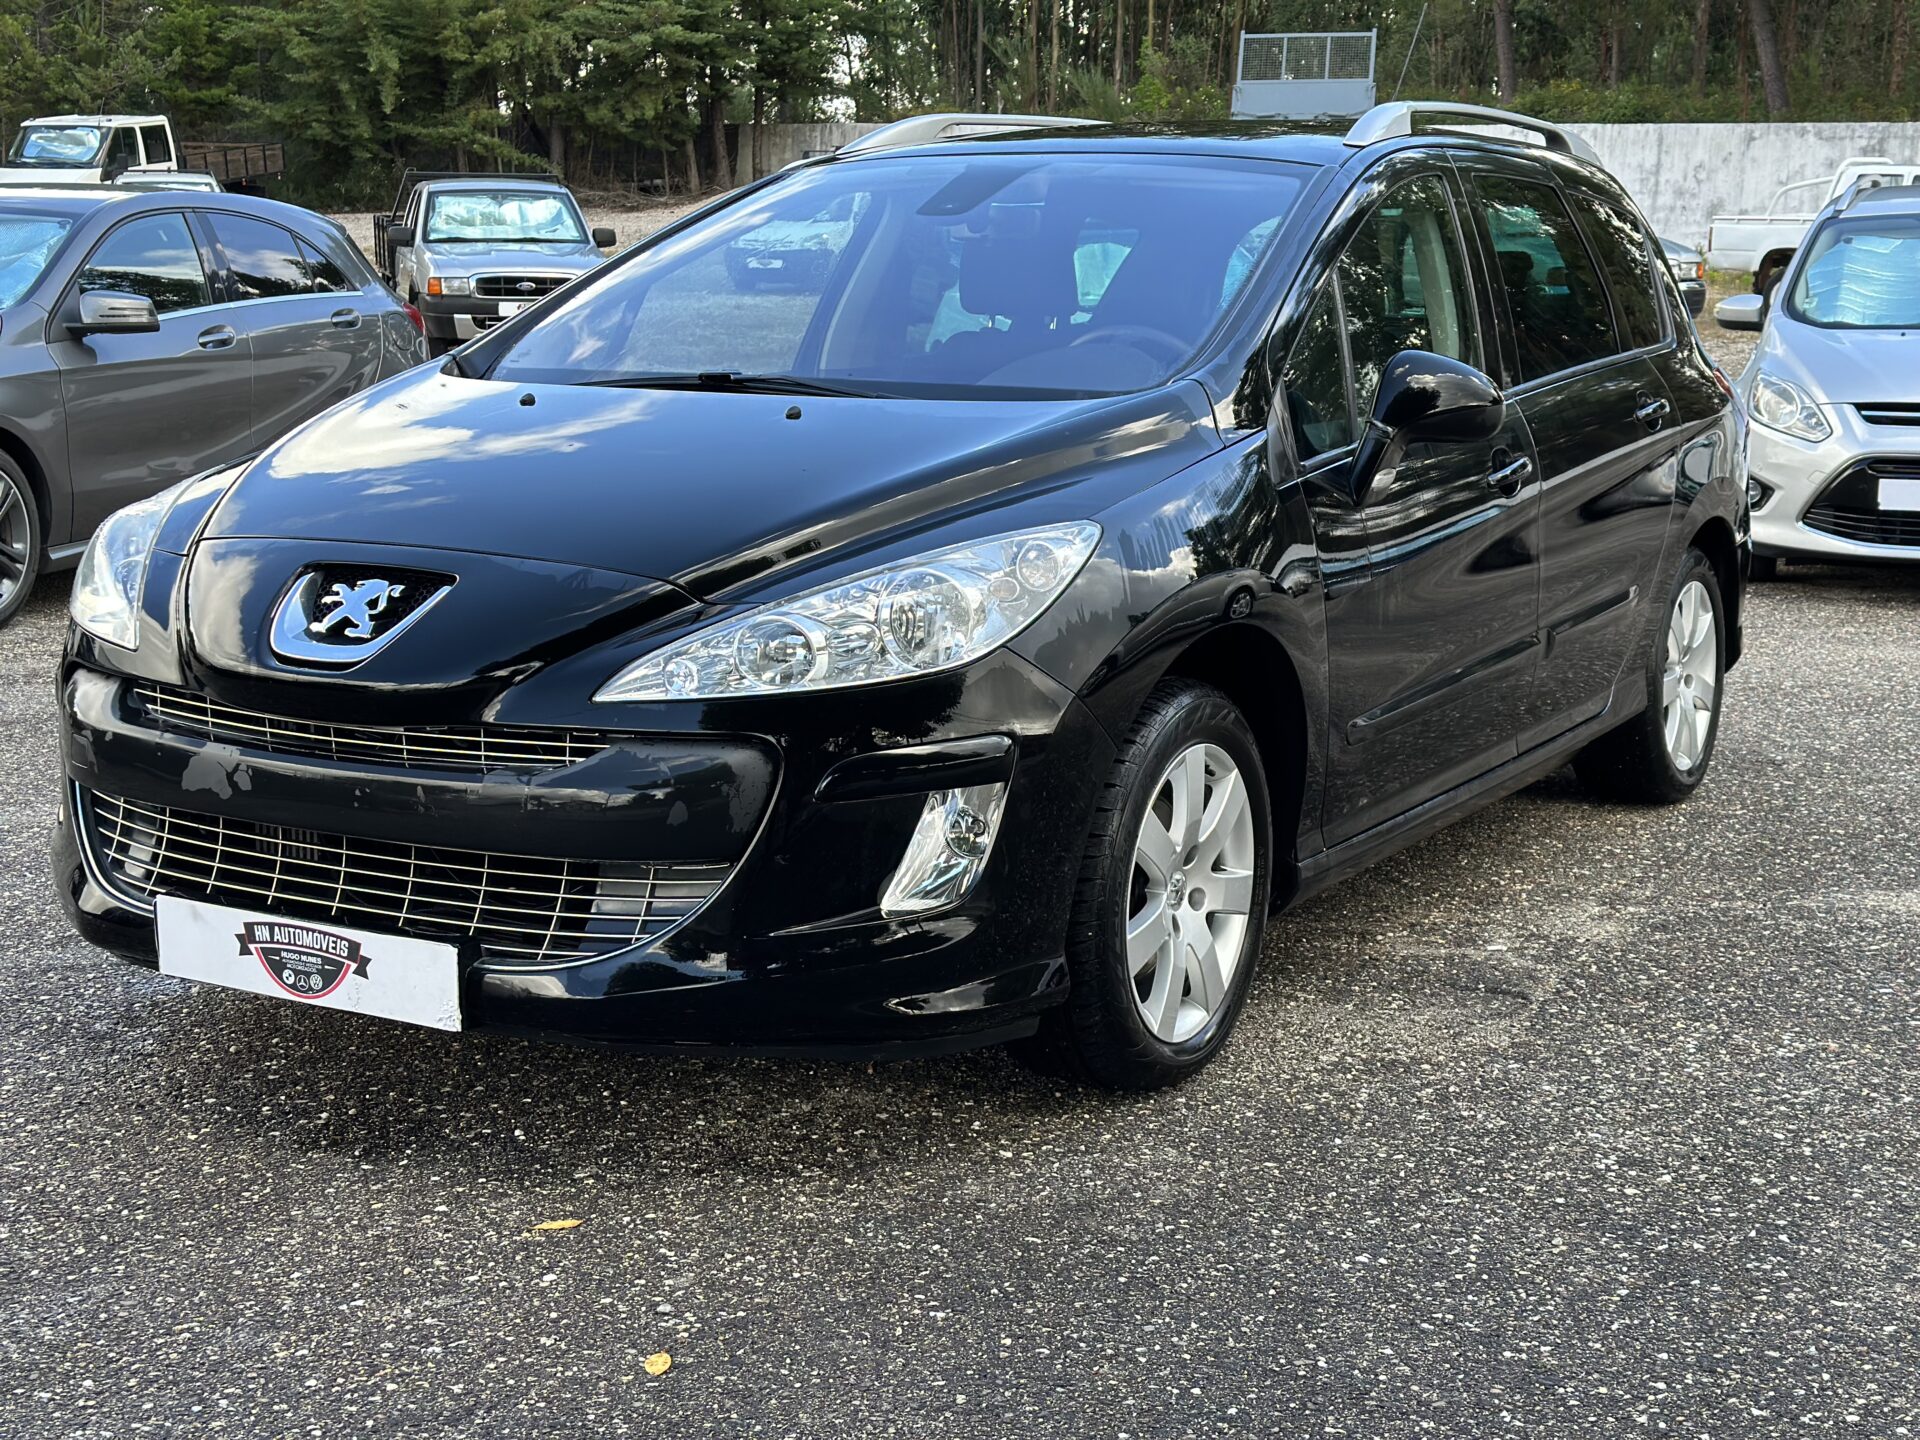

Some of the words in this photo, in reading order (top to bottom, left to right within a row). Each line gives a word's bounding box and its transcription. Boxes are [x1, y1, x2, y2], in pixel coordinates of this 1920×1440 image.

[254, 925, 271, 942] HN
[274, 925, 349, 957] AUTOMÓVEIS
[281, 950, 300, 961] HUGO
[300, 954, 322, 964] NUNES
